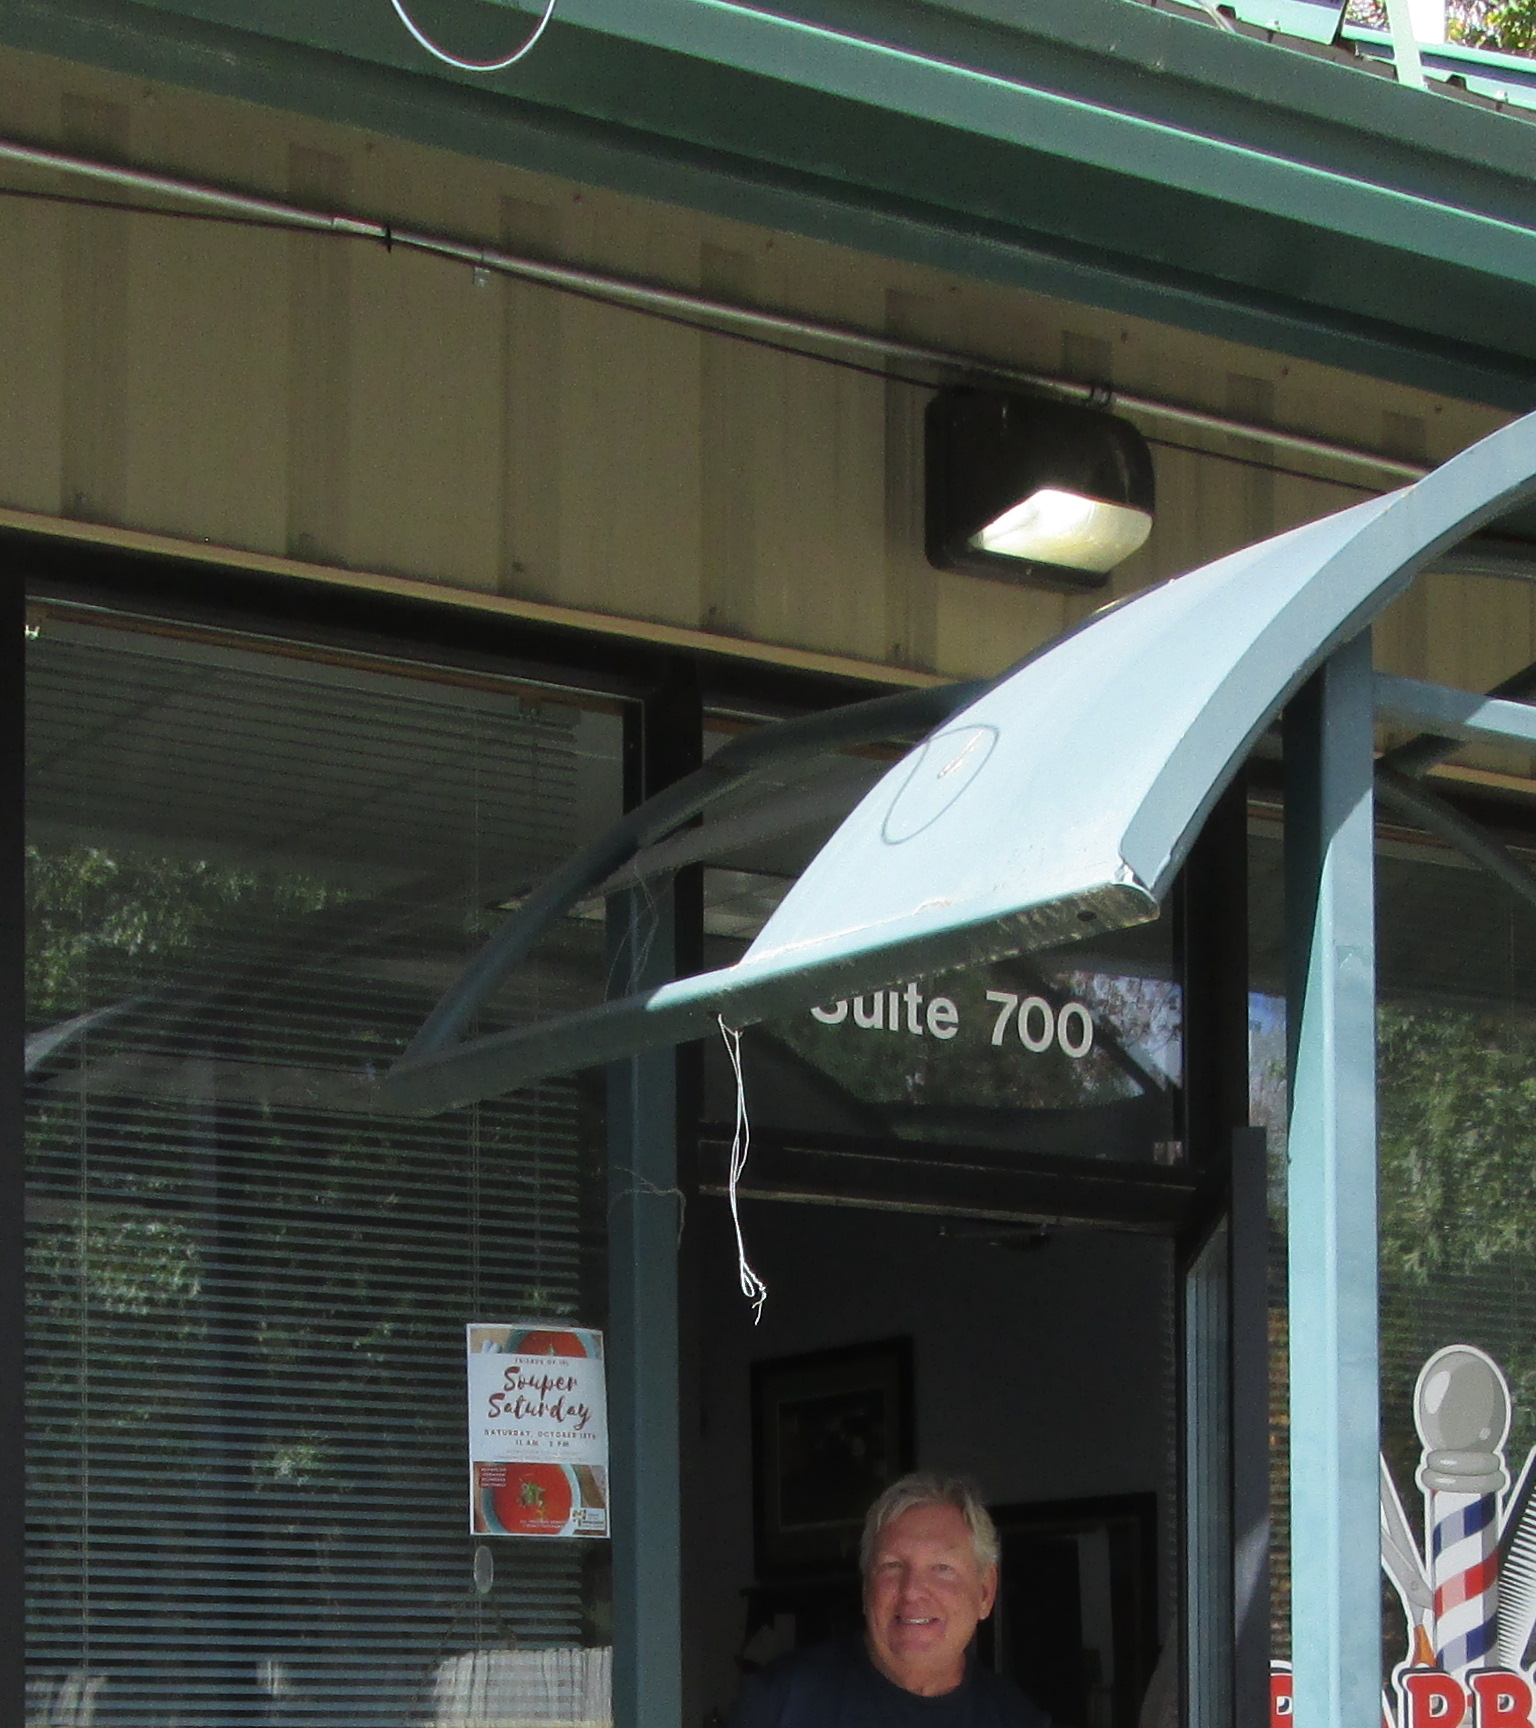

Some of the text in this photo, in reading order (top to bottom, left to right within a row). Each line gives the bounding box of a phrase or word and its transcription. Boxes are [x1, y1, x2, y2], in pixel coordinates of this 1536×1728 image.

[986, 989, 1094, 1059] 700
[504, 1366, 579, 1401] Souper
[487, 1393, 592, 1430] Saturday
